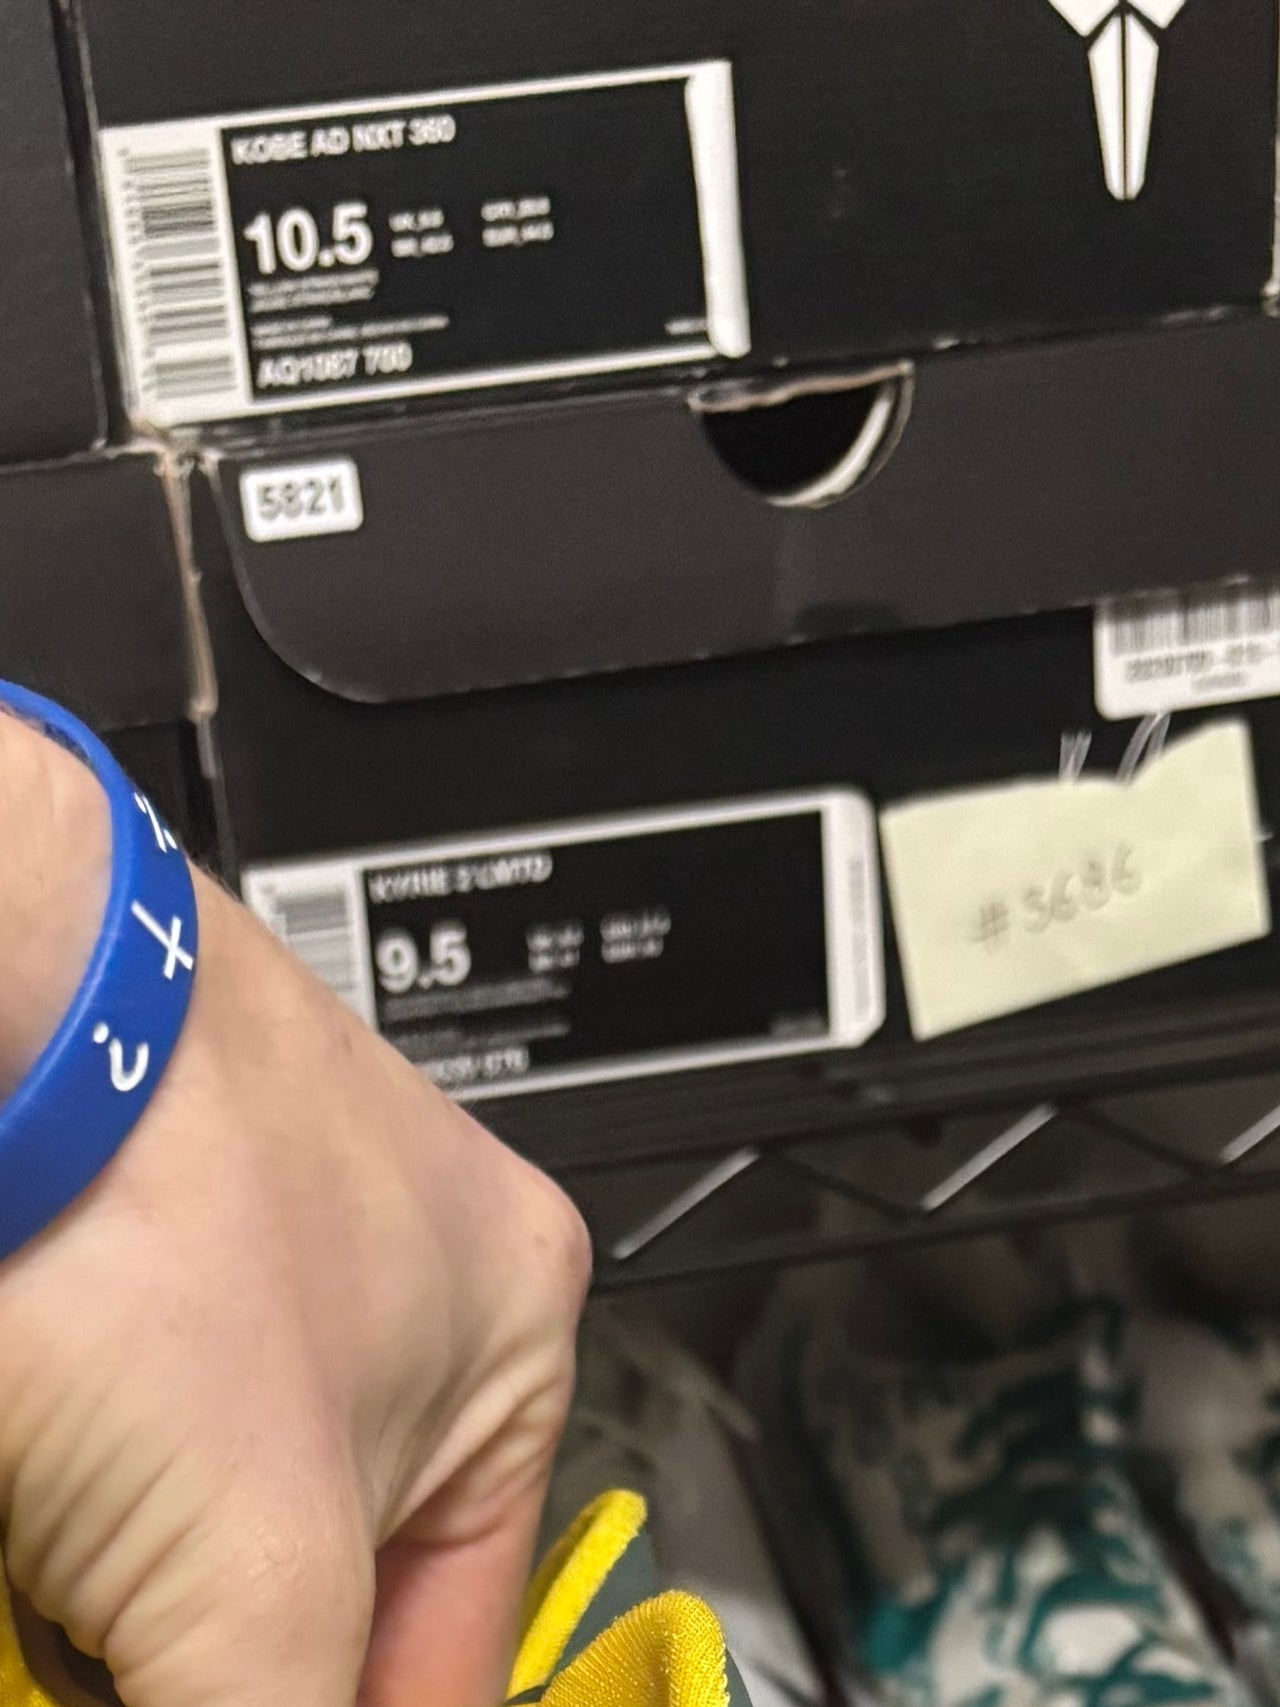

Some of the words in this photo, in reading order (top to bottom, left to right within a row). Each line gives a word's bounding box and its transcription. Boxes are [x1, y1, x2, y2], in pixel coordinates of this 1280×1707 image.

[230, 130, 308, 165] KOBE
[311, 126, 350, 157] AD
[243, 200, 373, 275] 10.5
[258, 473, 345, 520] 5821
[376, 919, 472, 993] 9.5
